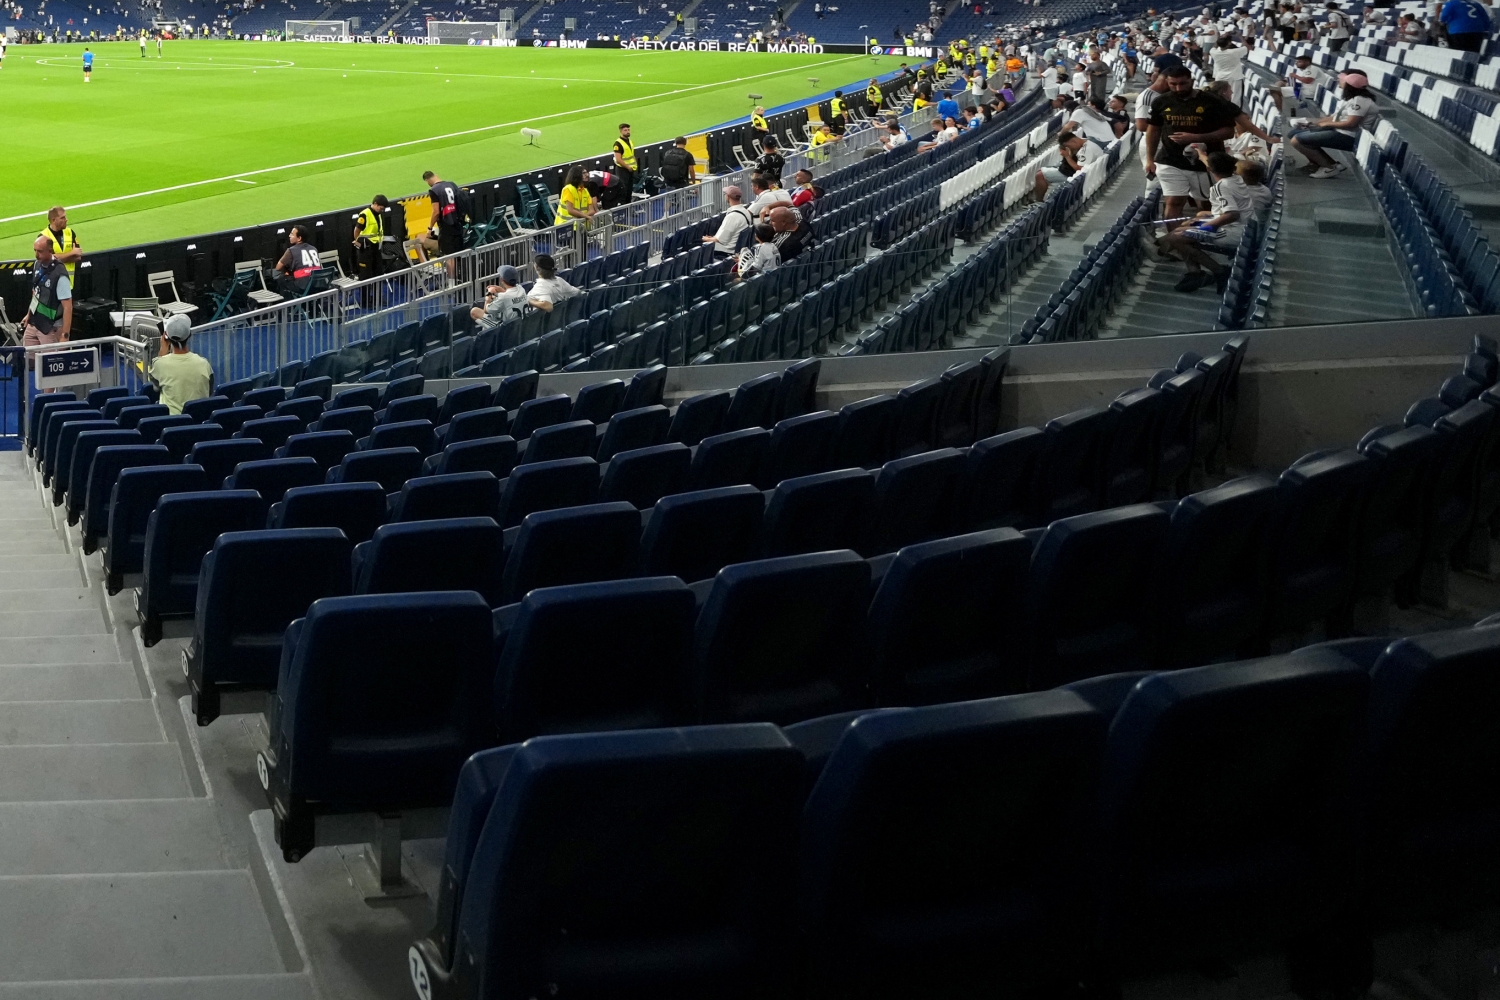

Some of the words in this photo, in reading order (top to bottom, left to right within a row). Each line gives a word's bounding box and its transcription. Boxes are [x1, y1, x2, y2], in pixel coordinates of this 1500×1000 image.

[337, 35, 355, 43] CAR
[376, 36, 401, 44] REAL
[403, 36, 441, 45] MADRID
[491, 39, 518, 47] BMW
[560, 40, 587, 48] BMW
[620, 41, 667, 50] SAFETY
[669, 41, 695, 51] CAR
[767, 43, 824, 54] MADRID
[906, 46, 933, 58] BMW
[1166, 113, 1203, 122] Emirates
[301, 249, 321, 267] 48
[48, 362, 64, 373] 109
